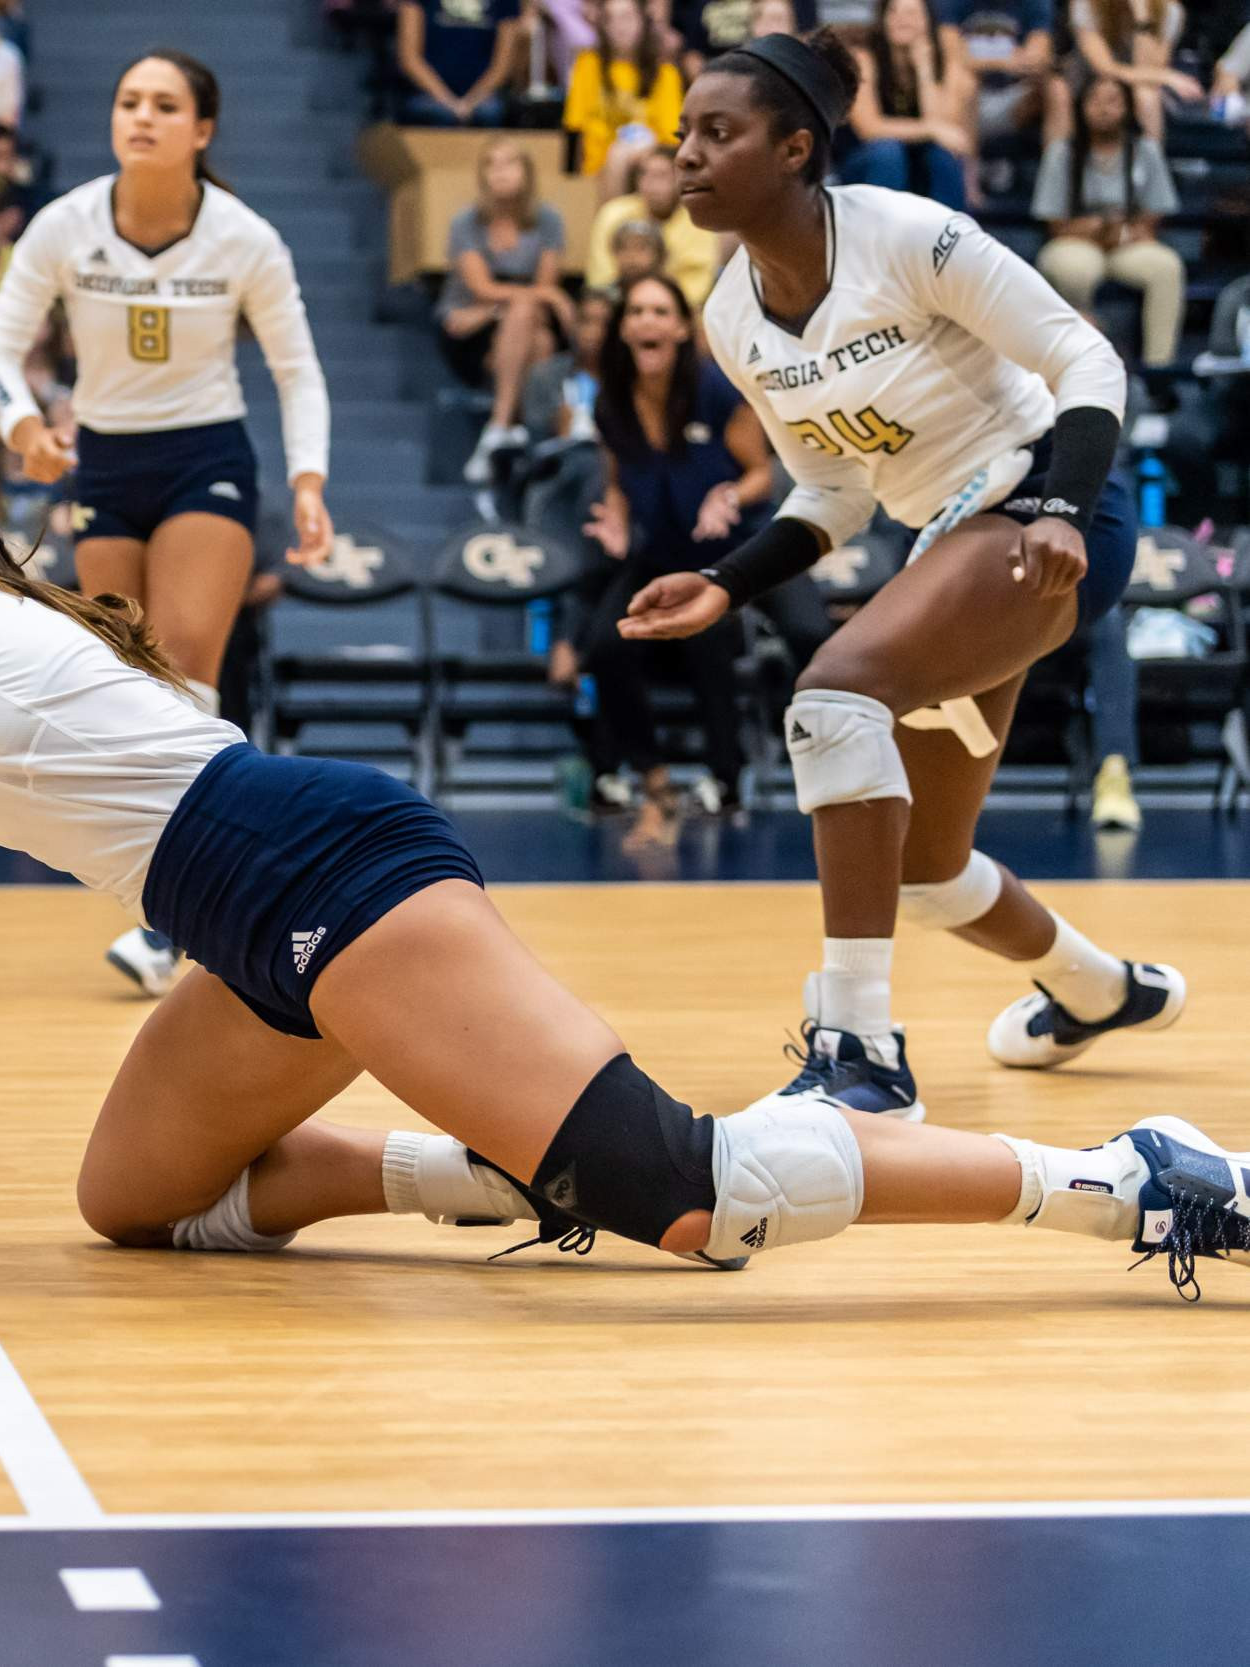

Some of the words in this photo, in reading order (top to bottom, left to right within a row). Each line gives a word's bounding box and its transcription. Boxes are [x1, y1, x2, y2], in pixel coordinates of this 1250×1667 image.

[933, 224, 958, 271] ACC
[127, 305, 170, 364] 8
[827, 325, 906, 372] TECH
[296, 926, 327, 974] adidas
